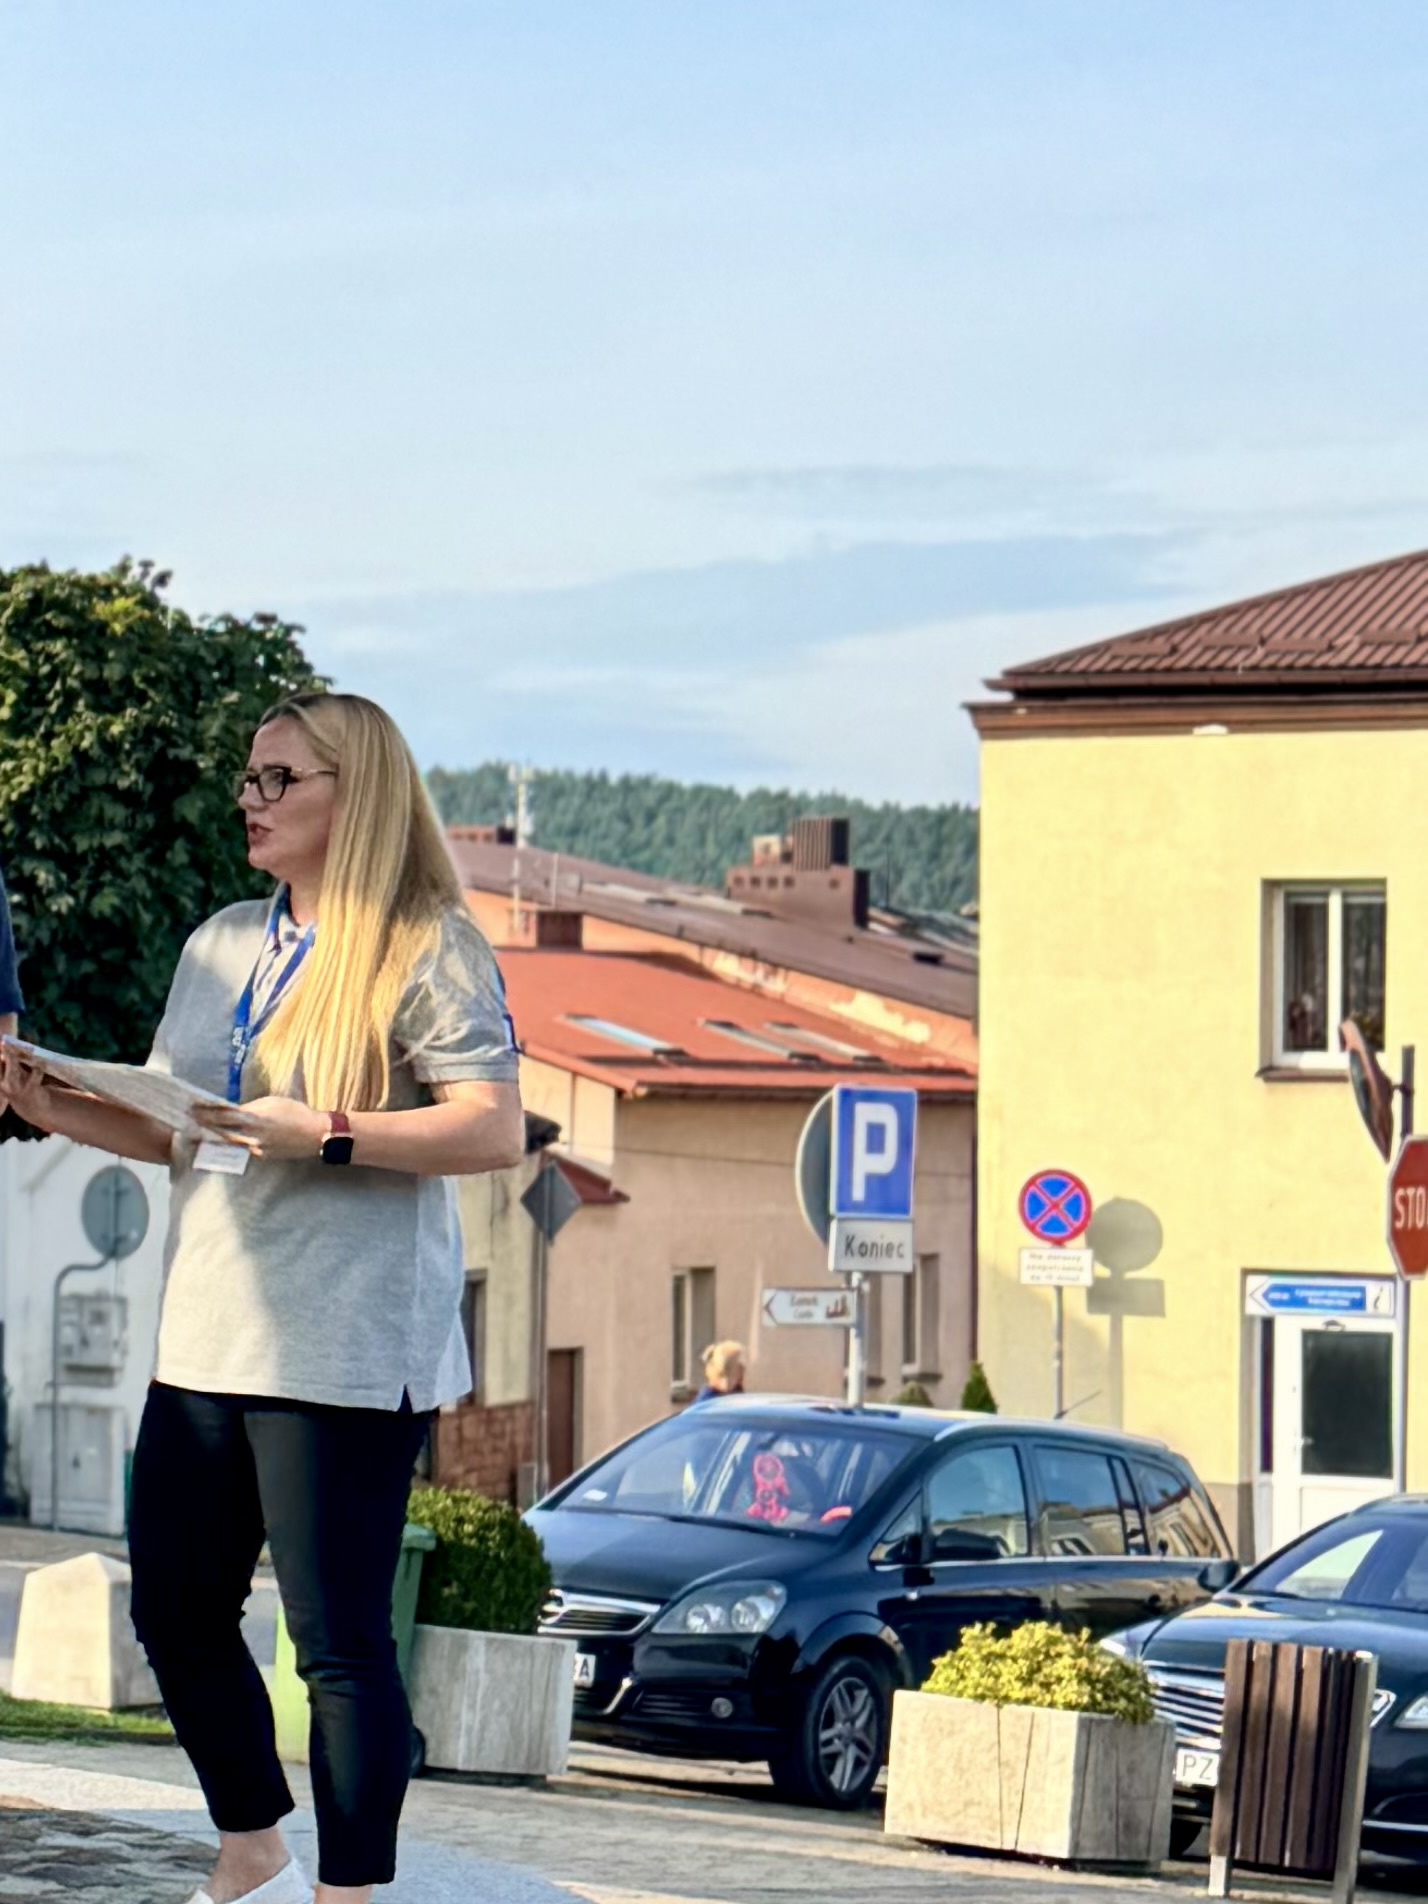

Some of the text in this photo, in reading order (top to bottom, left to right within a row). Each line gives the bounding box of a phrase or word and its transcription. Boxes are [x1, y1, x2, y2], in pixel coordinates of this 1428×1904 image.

[852, 1102, 898, 1201] P
[1395, 1185, 1428, 1230] STO
[844, 1233, 905, 1259] Koniec
[1183, 1754, 1213, 1781] PZ
